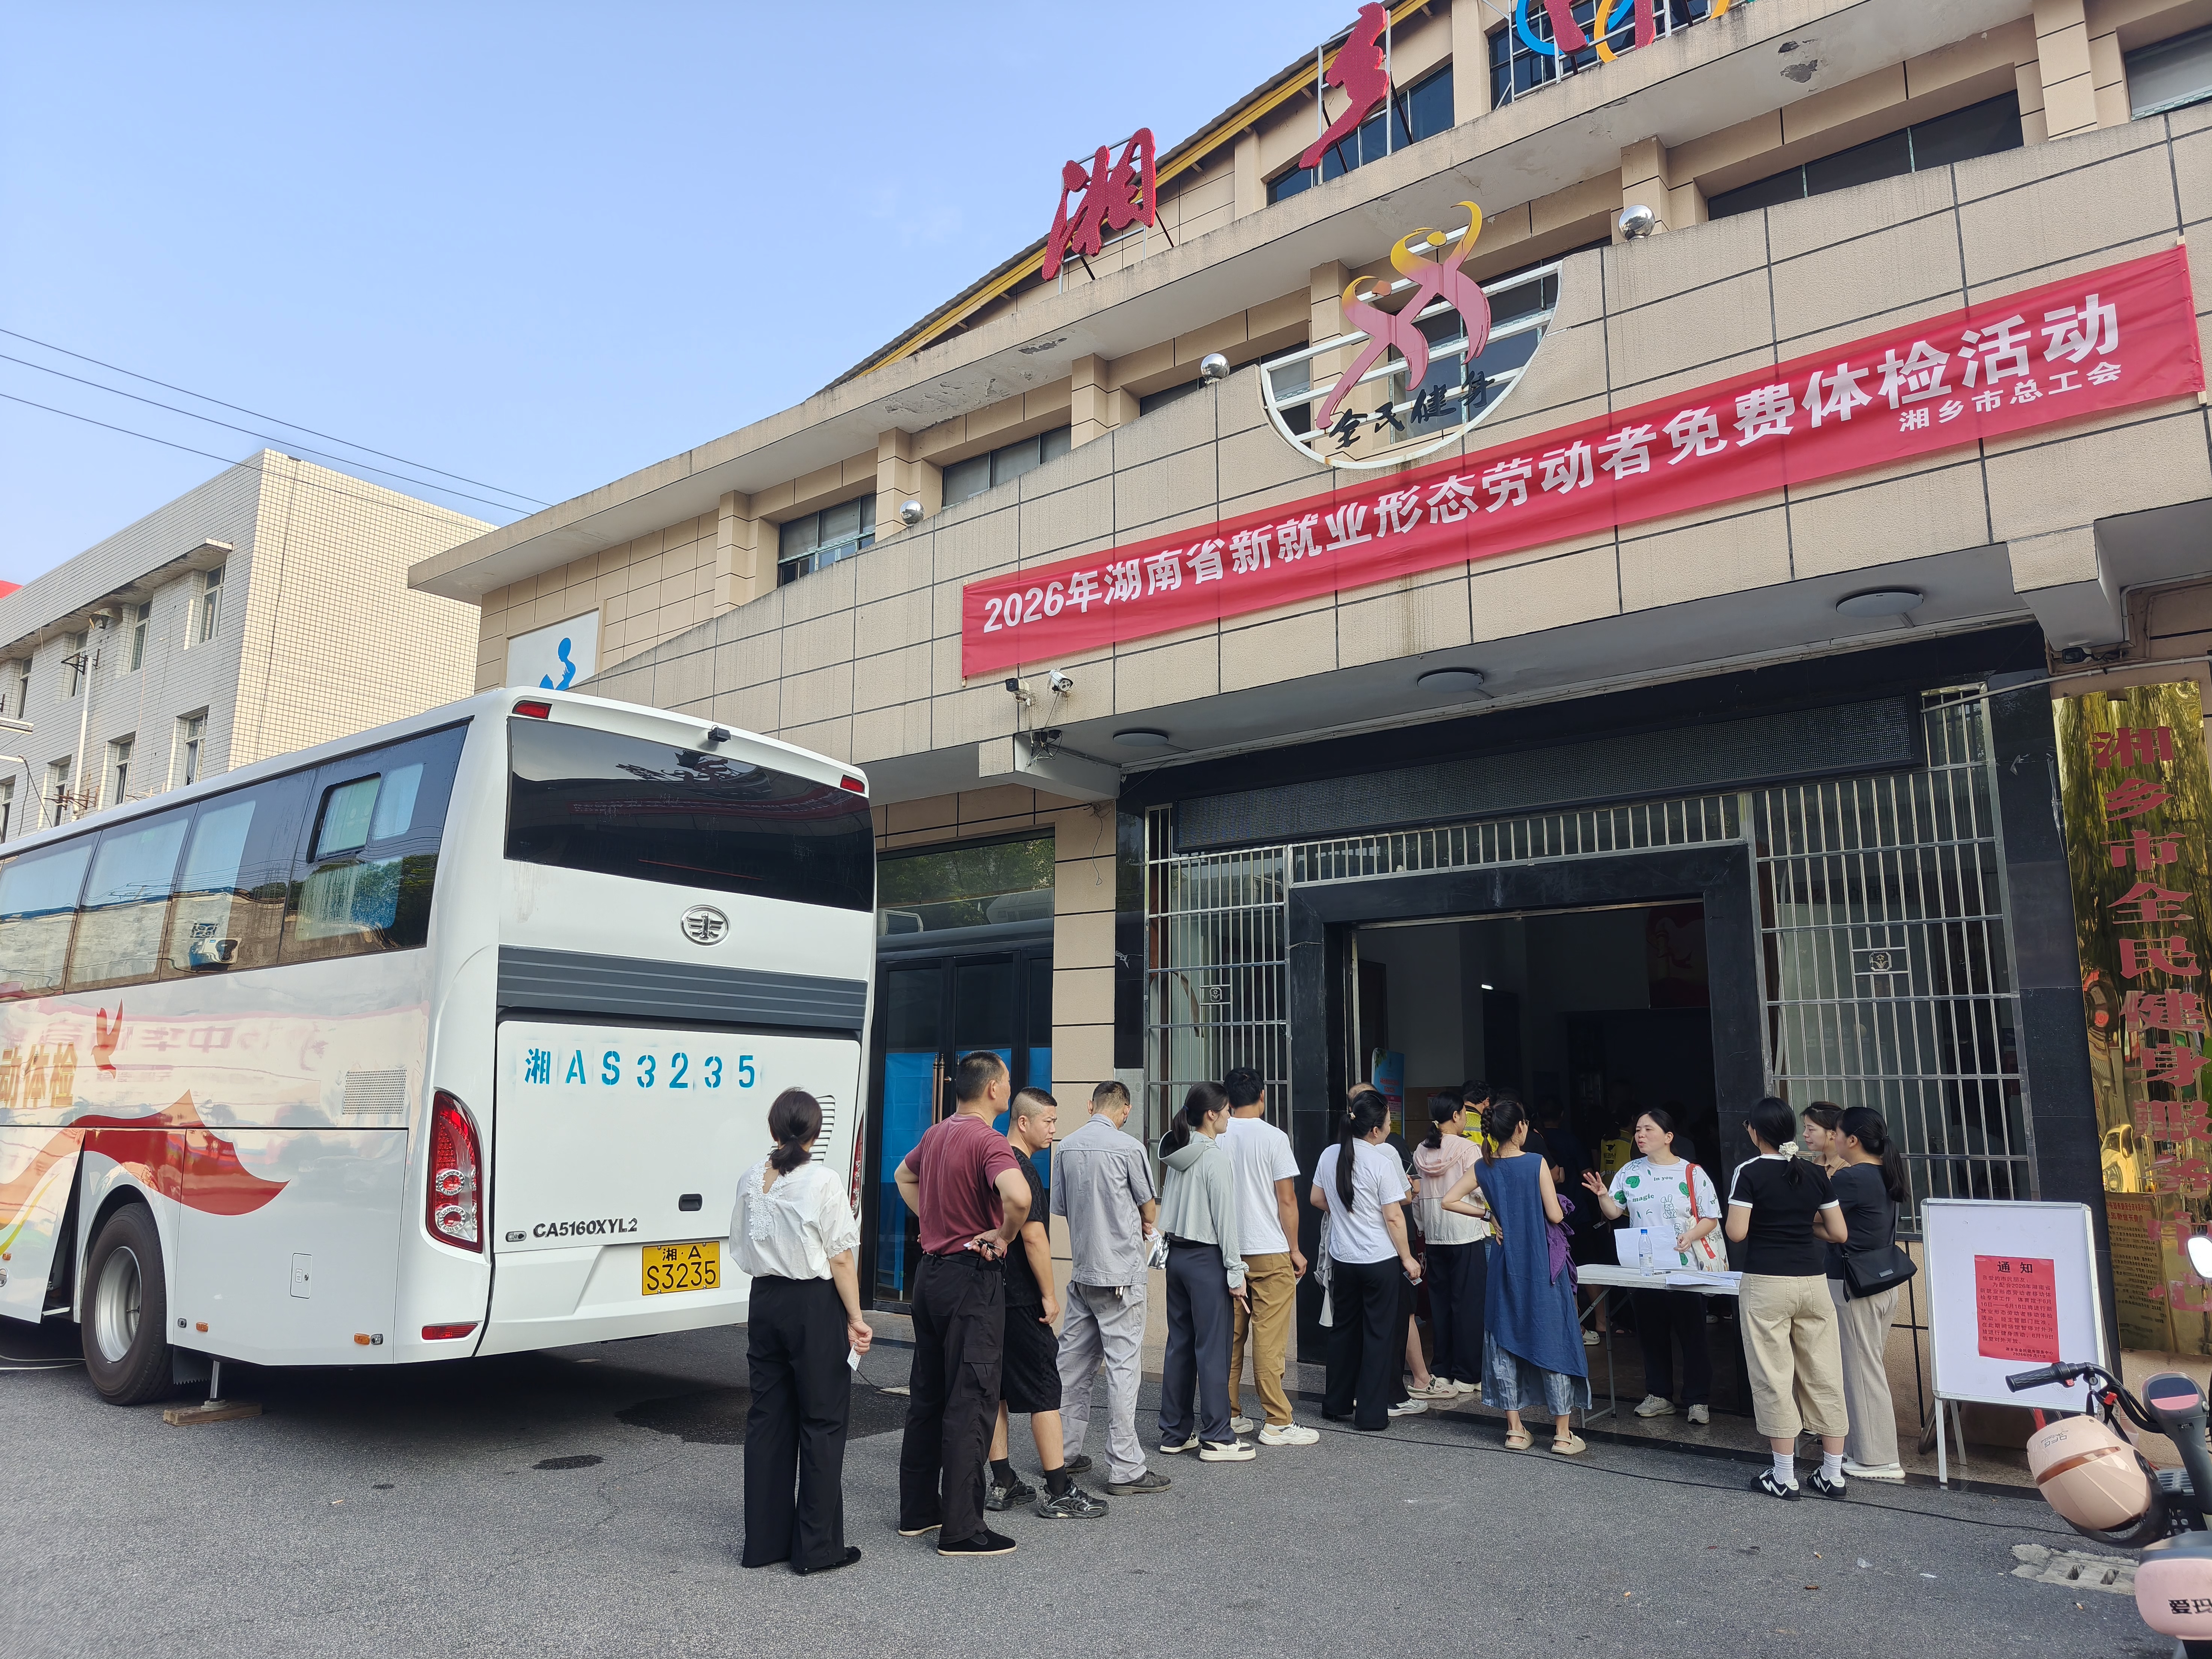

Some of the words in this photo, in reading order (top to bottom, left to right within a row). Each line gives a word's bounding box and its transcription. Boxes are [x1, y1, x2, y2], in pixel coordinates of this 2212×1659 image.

[1329, 370, 1495, 449] 全民健身
[1899, 361, 2122, 431] 湘乡市总工会
[984, 293, 2119, 634] 2026年湖南省新就业形态劳动者免费体检活动
[1632, 1194, 1654, 1202] magic
[533, 1218, 638, 1238] CA5160XYL2
[647, 1258, 716, 1290] S3235
[1997, 1261, 2033, 1274] 通知
